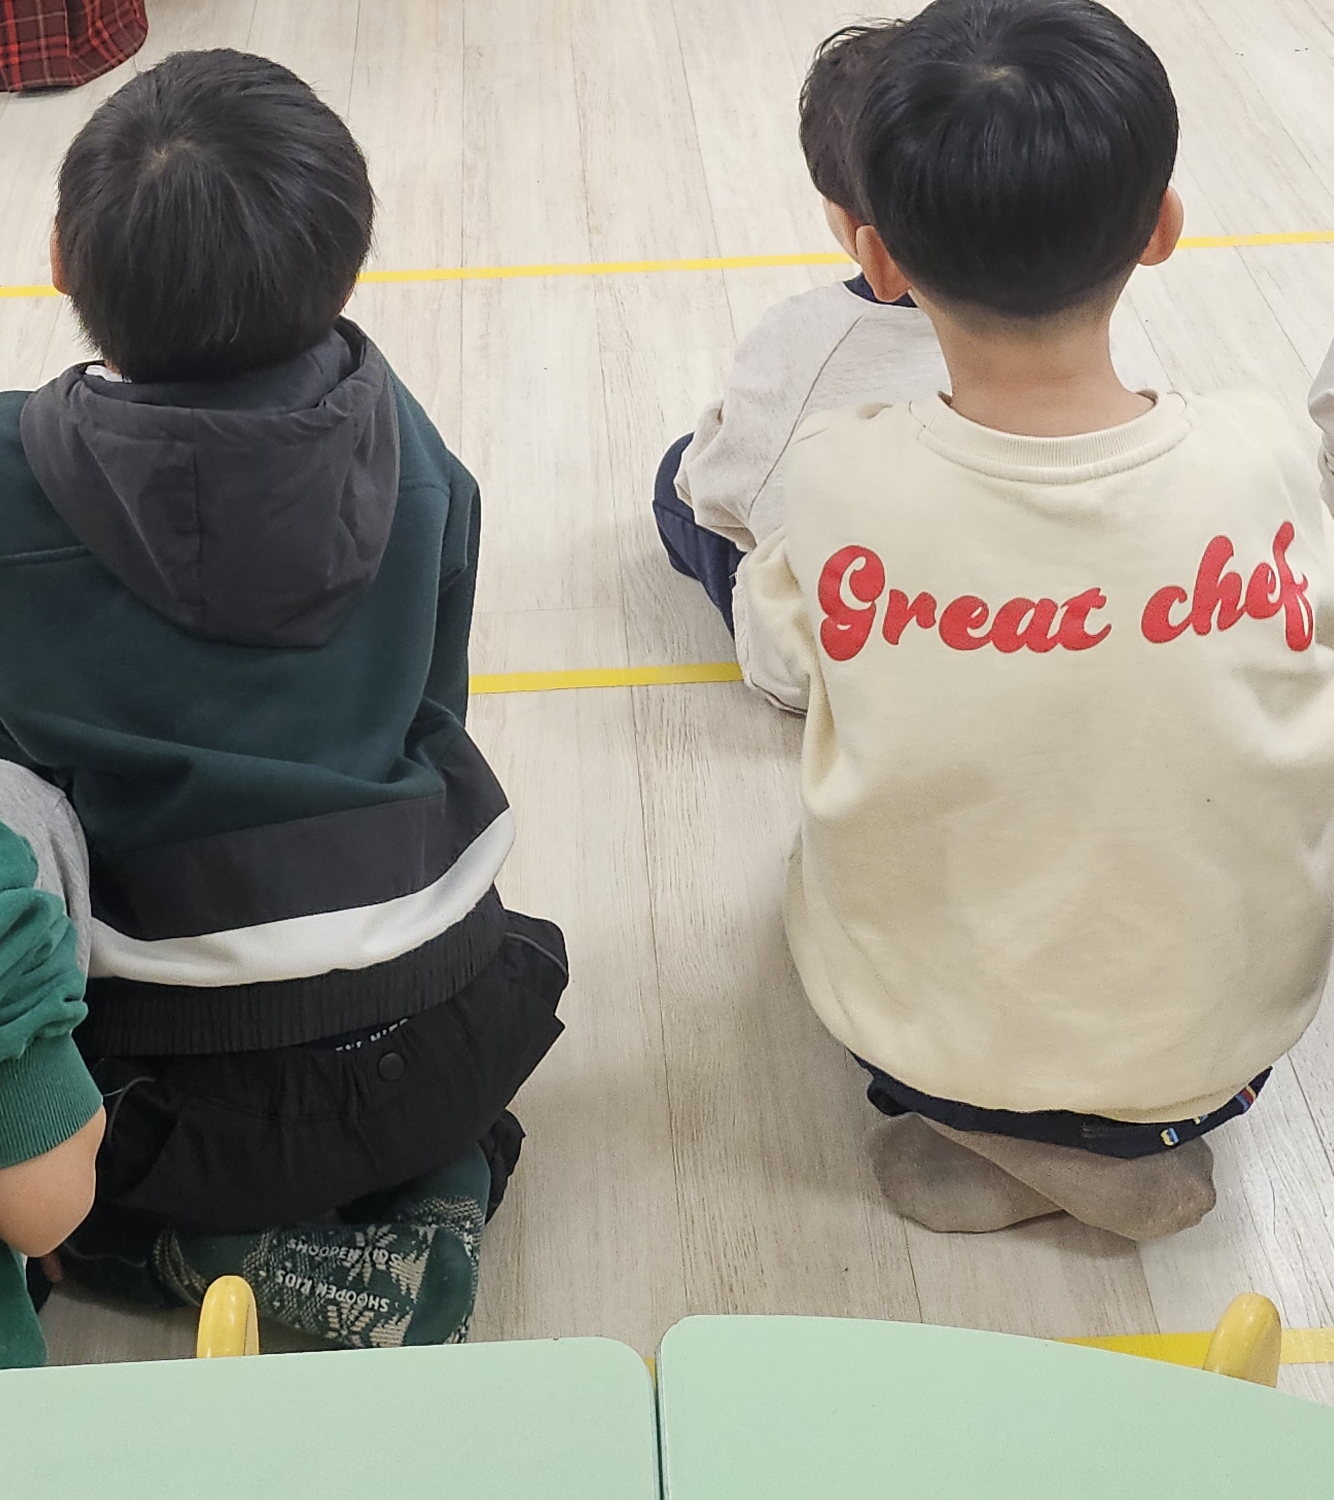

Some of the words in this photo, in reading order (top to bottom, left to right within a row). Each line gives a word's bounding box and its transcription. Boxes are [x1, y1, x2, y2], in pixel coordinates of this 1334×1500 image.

[817, 543, 1113, 661] Great
[1140, 519, 1314, 652] chef
[275, 1269, 313, 1296] KIDS
[314, 1281, 390, 1313] SHOOPEN
